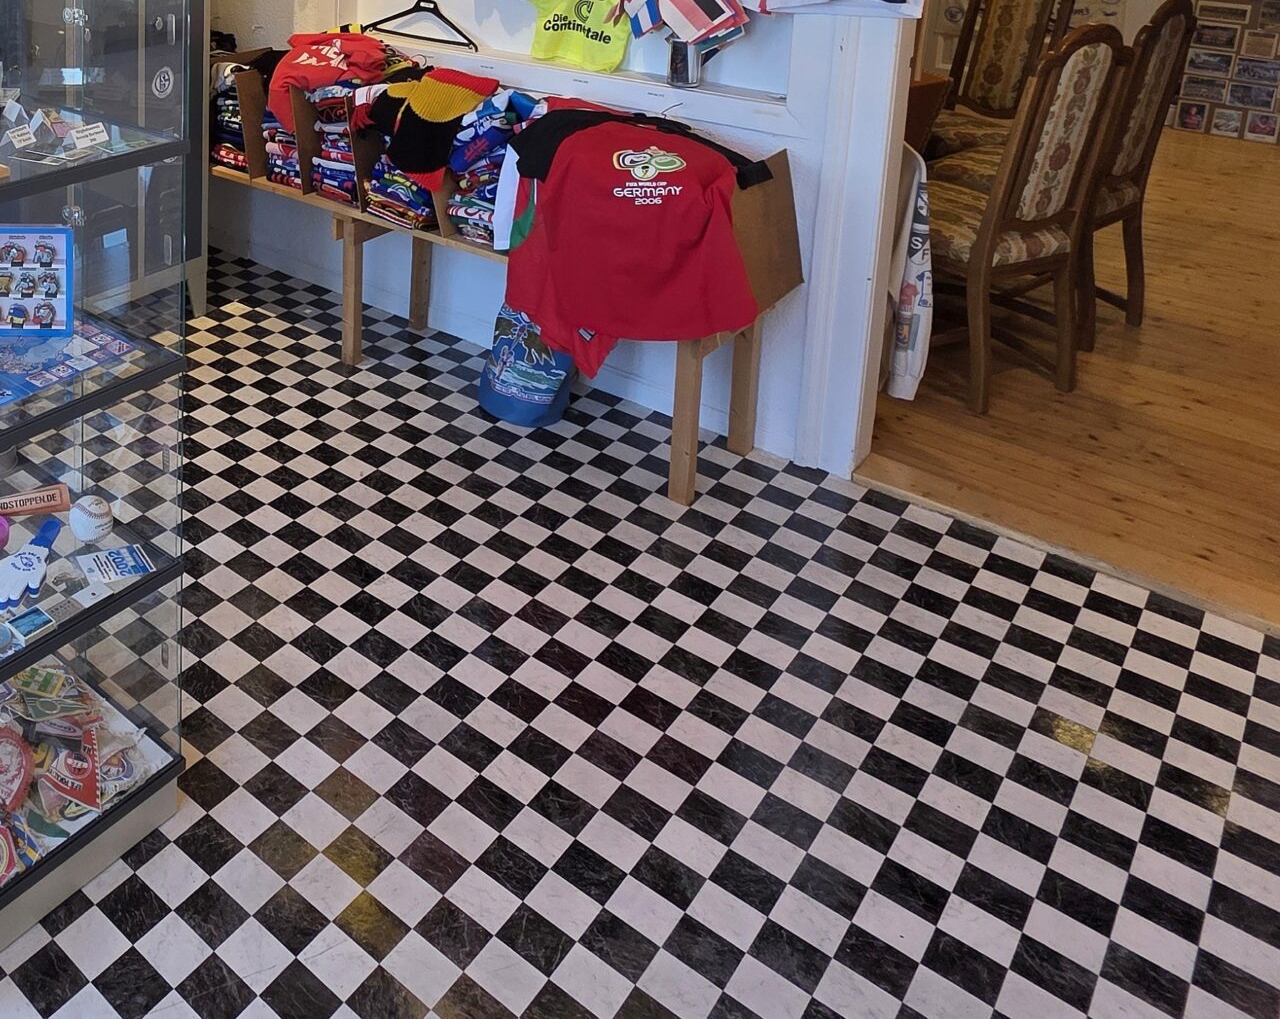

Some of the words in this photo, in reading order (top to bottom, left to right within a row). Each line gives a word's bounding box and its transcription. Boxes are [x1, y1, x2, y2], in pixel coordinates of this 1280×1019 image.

[553, 14, 569, 23] Die
[613, 186, 683, 198] GERMANY
[635, 197, 663, 206] 2006
[109, 549, 133, 577] 2002
